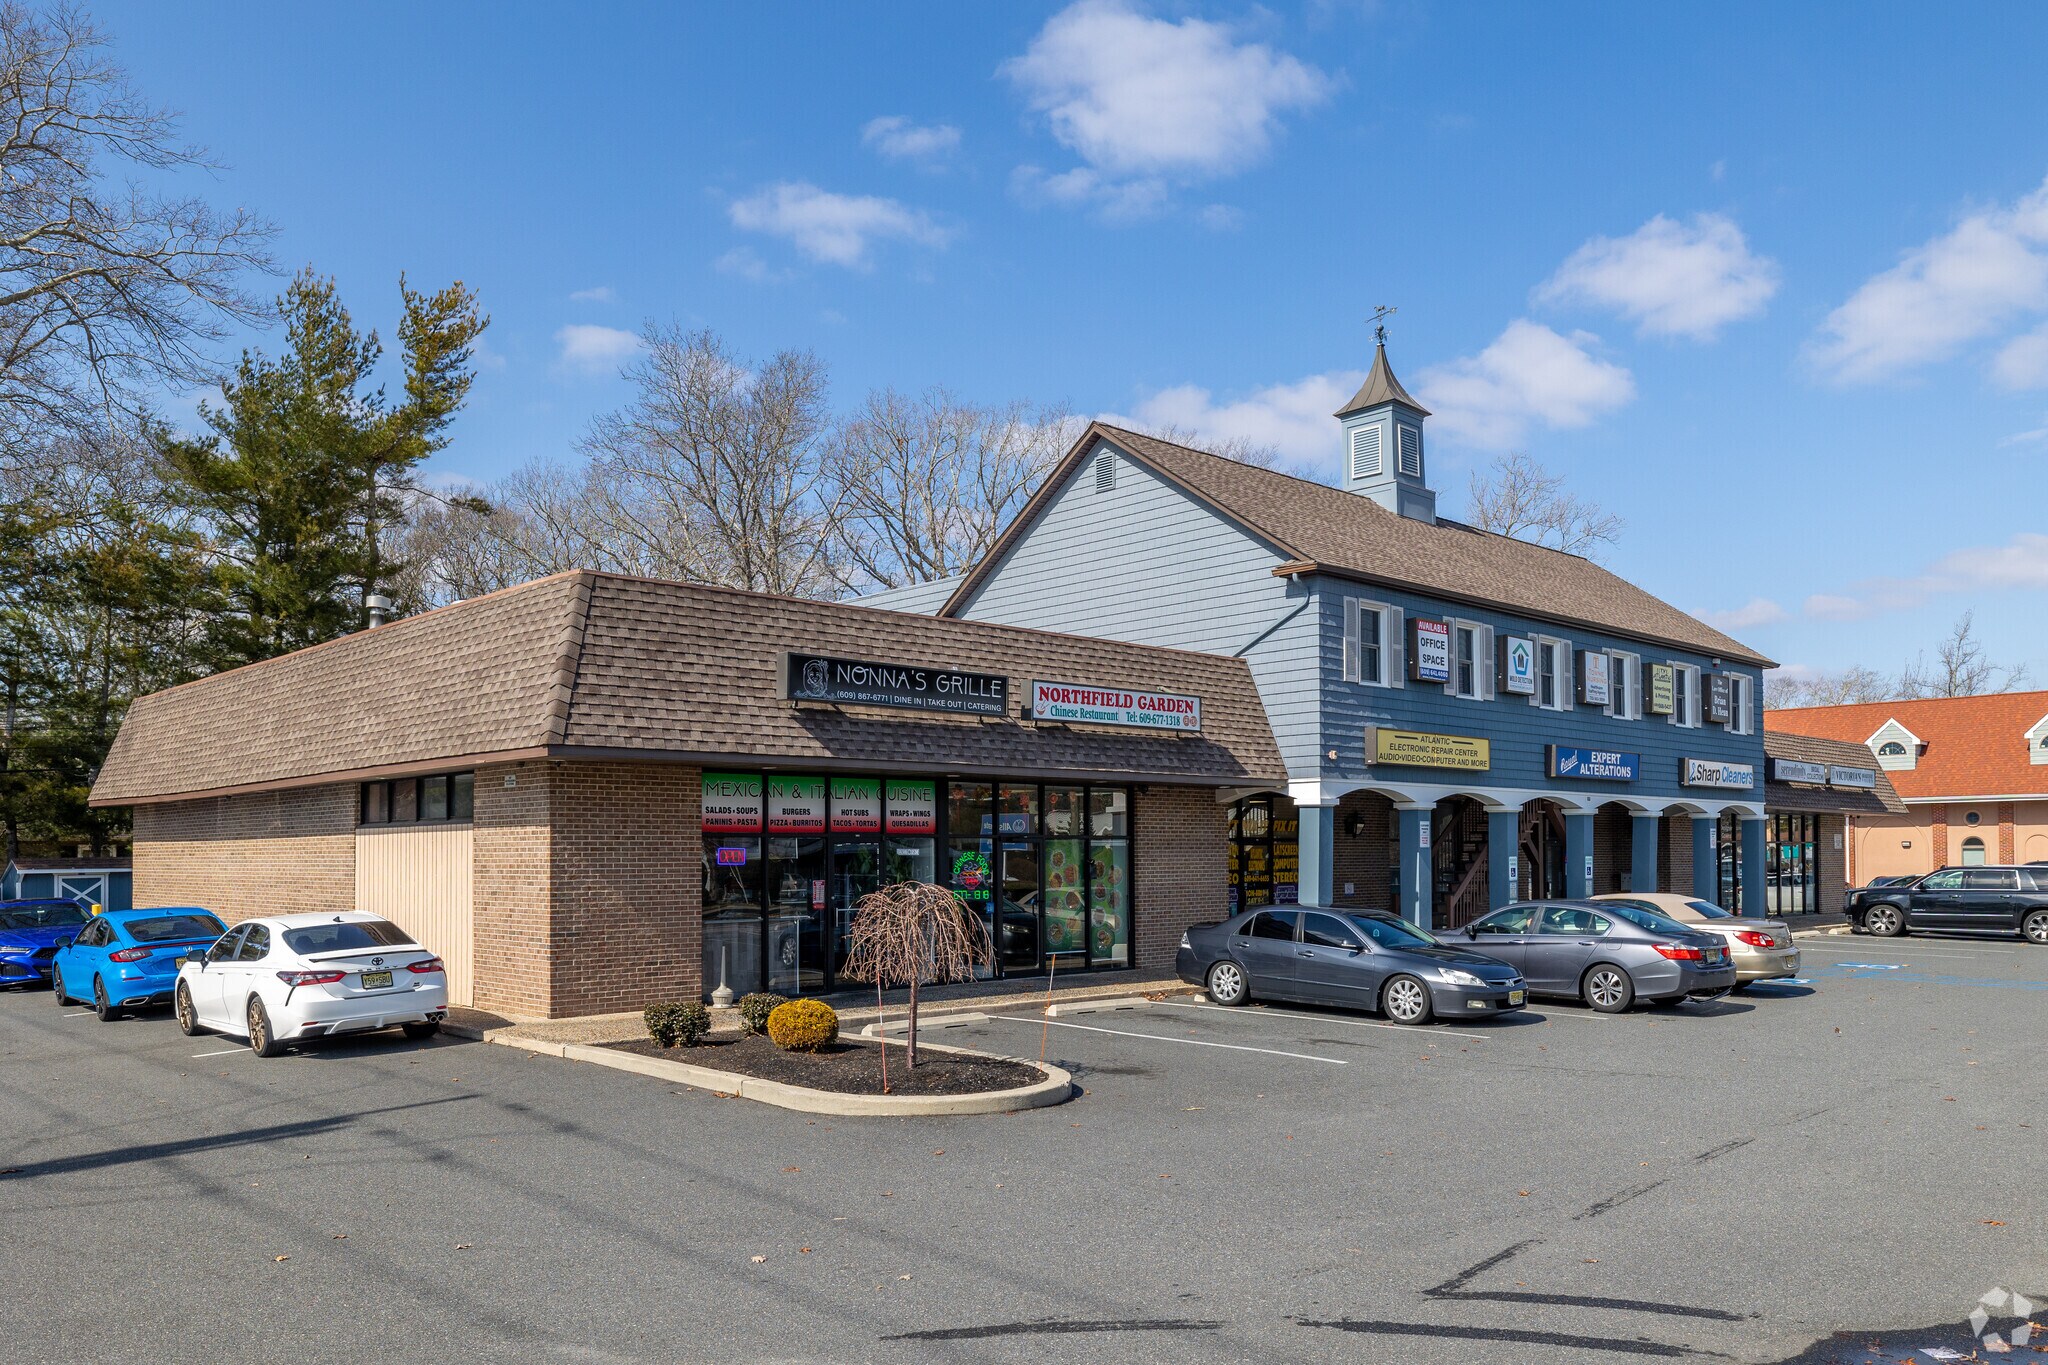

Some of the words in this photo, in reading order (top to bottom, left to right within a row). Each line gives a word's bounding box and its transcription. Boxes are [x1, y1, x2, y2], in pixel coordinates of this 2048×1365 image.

[1418, 621, 1447, 634] AVAILABLE
[1420, 637, 1446, 650] OFFICE
[1422, 653, 1445, 667] SPACE
[836, 663, 927, 691] NONNA'S
[935, 674, 1002, 698] GRILLE
[836, 691, 856, 700] (609)
[857, 692, 889, 702] 867-6771
[894, 695, 912, 704] DINE
[913, 697, 922, 705] IN
[928, 698, 946, 707] TAKE
[947, 700, 962, 708] OUT
[967, 702, 1002, 712] CATERING
[1038, 686, 1134, 709] NORTHFIELD
[1137, 695, 1194, 714] GARDEN
[1050, 705, 1079, 719] Chinese
[1080, 708, 1119, 721] Restaurant
[1126, 711, 1138, 723] Tel:
[1420, 735, 1450, 745] ATLANTIC
[1389, 743, 1430, 753] ELECTRONIC
[1431, 746, 1453, 755] REPAIR
[1454, 748, 1478, 757] CENTER
[1457, 758, 1469, 766] AND
[1470, 759, 1488, 768] MORE
[1591, 751, 1621, 765] EXPERT
[1580, 763, 1632, 778] ALTERATIONS
[1696, 763, 1720, 786] Sharp
[1721, 765, 1753, 785] Cleaners
[791, 783, 802, 799] &
[705, 806, 732, 814] SALADS
[736, 806, 758, 815] SOUPS
[782, 808, 811, 816] BURGERS
[854, 809, 869, 817] SUBS
[705, 818, 732, 826] PANINIS
[737, 818, 757, 826] PASTA
[792, 819, 822, 827] BURRITOS
[856, 820, 877, 828] TORTAS
[891, 820, 929, 828] QUESADILLAS
[1273, 820, 1287, 832] FIX
[720, 849, 744, 863] OPEN
[953, 851, 975, 874] CHINESE
